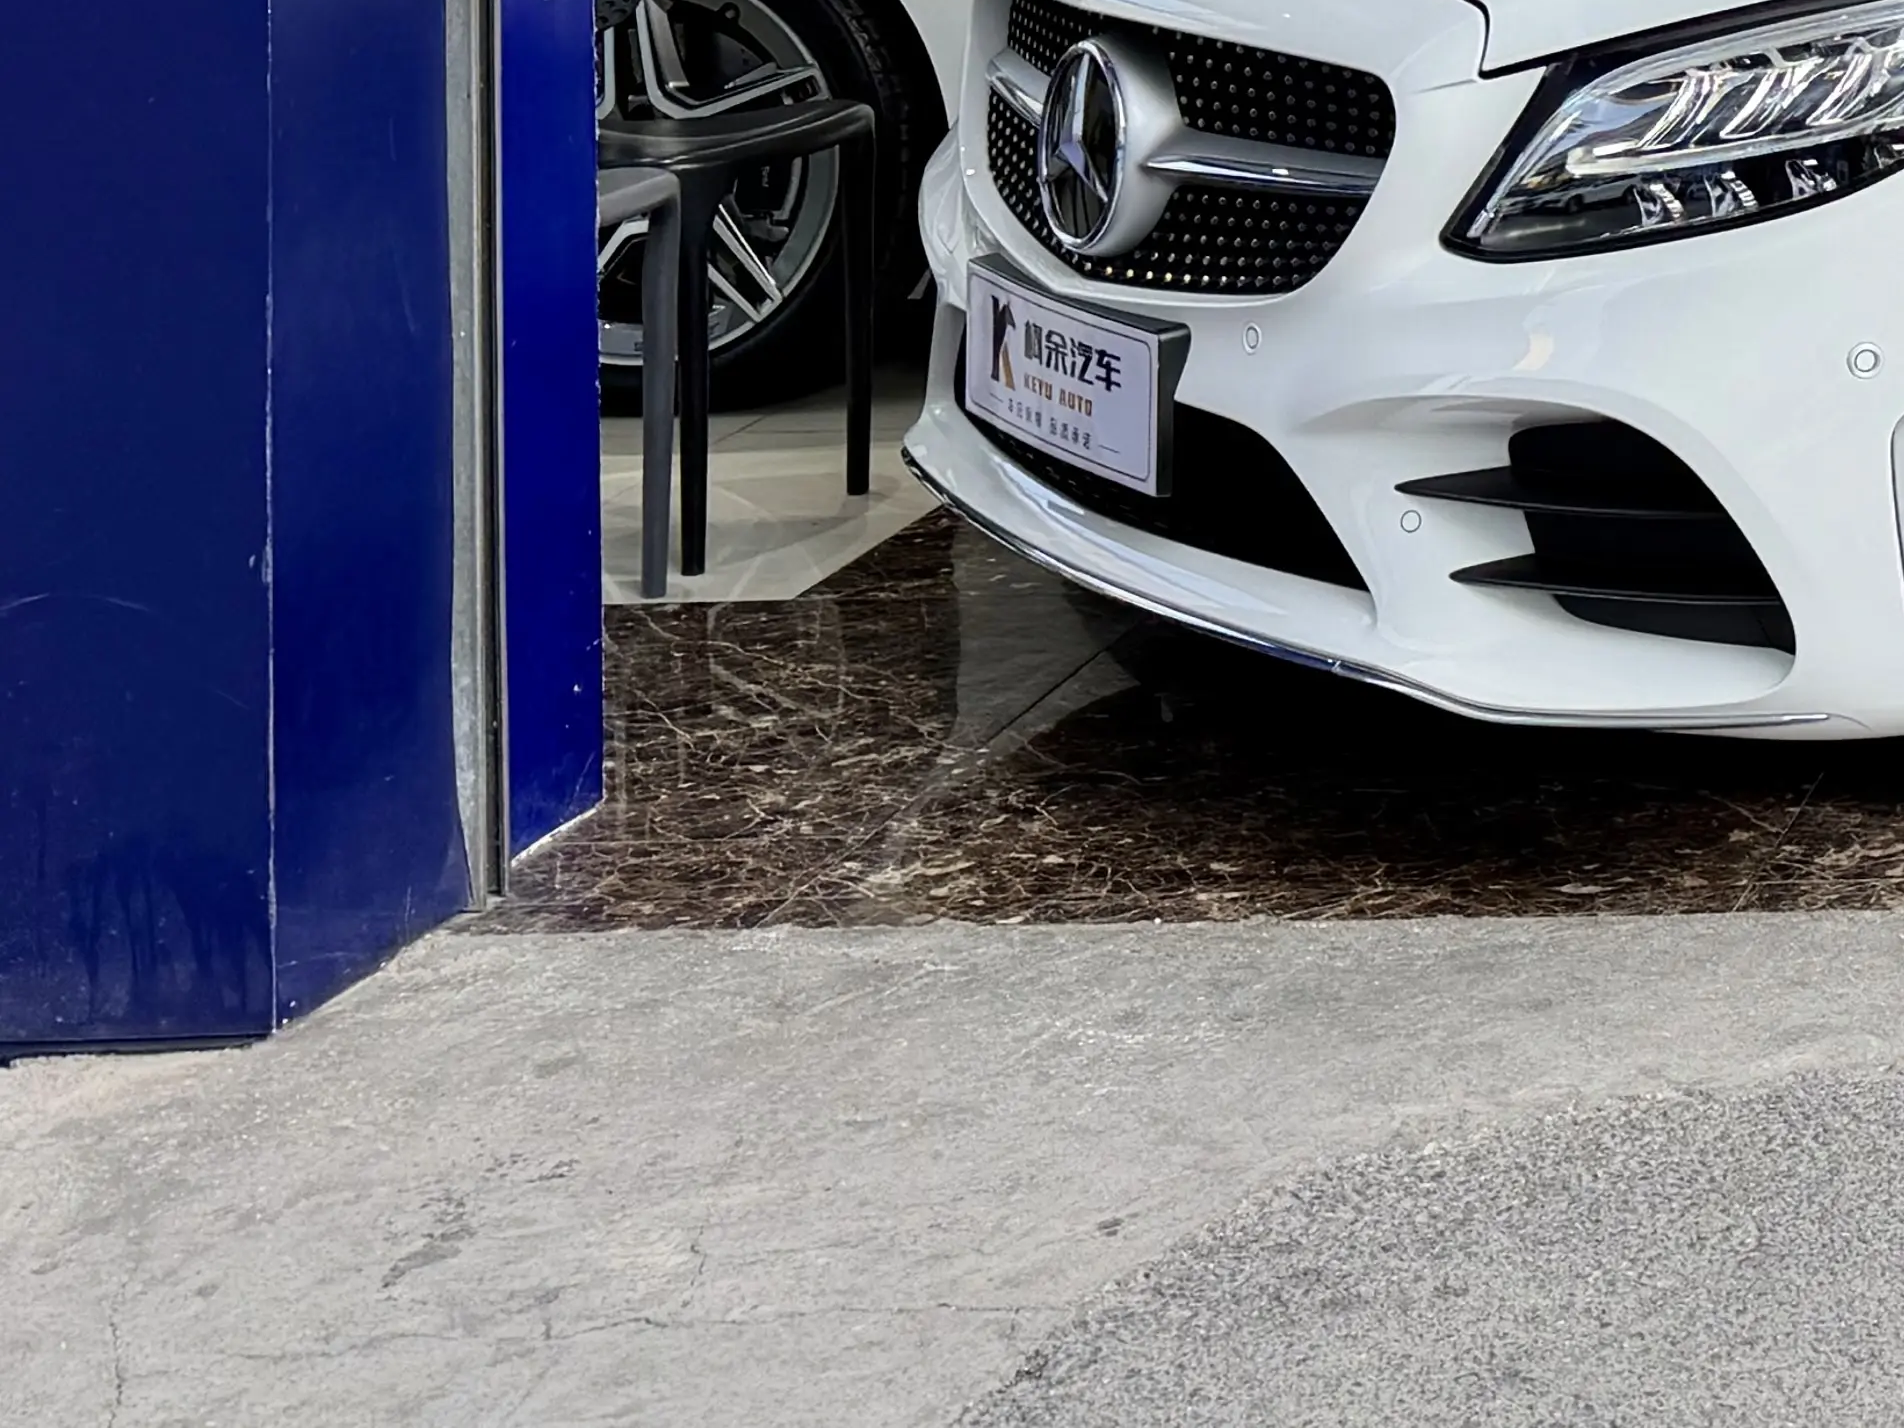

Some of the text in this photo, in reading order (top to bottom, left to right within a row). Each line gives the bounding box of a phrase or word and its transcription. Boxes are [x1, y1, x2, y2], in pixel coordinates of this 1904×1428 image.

[1024, 319, 1121, 392] 柯余汽车
[1024, 373, 1093, 417] KEYU AUTO
